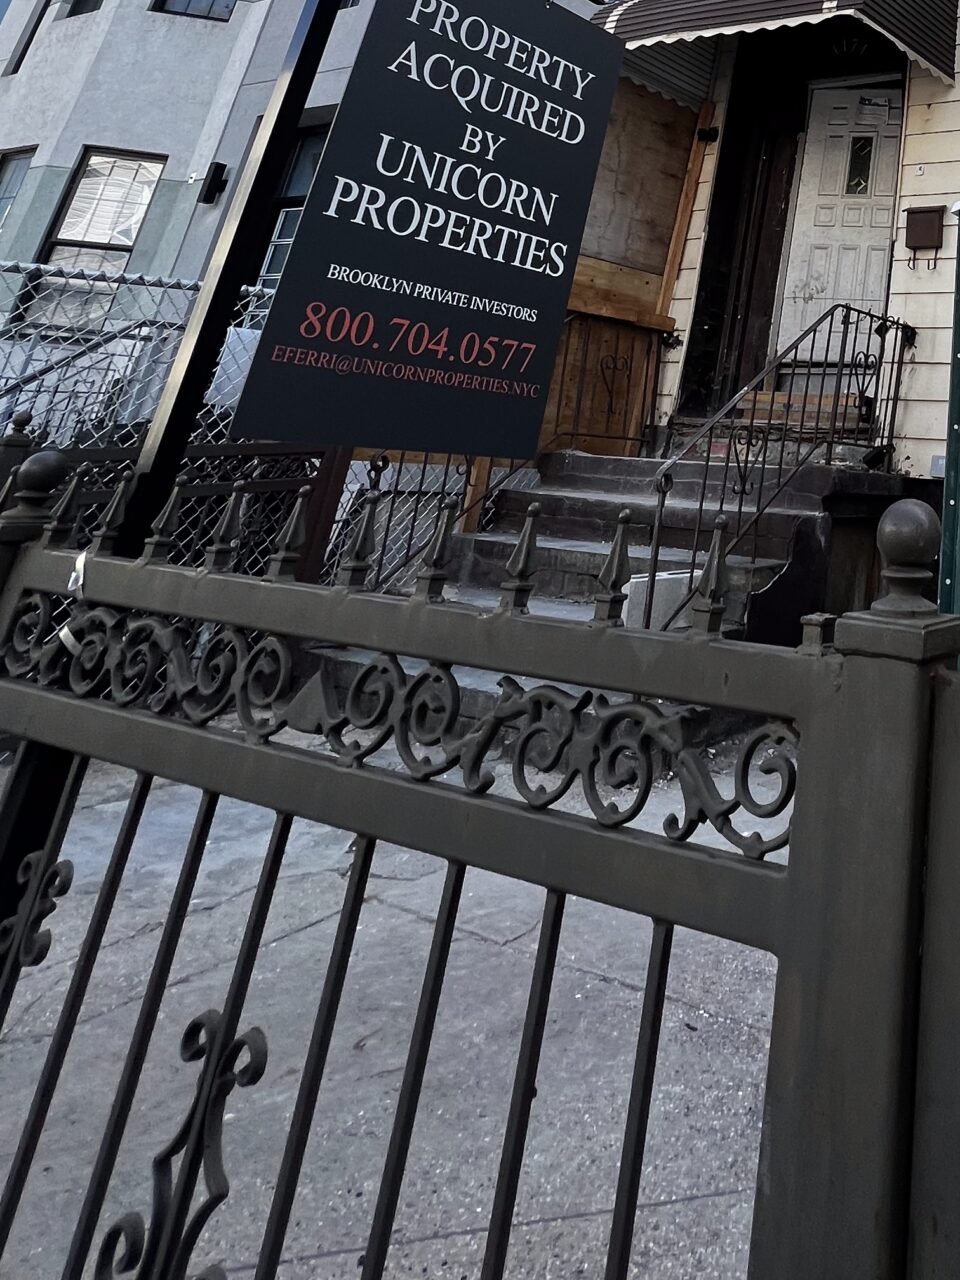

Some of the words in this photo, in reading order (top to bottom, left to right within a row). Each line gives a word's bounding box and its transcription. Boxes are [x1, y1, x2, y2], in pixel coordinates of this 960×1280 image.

[387, 43, 585, 144] ACQUIRED
[459, 123, 506, 161] BY
[376, 133, 559, 226] UNICORN
[323, 176, 567, 277] PROPERTIES
[327, 264, 413, 295] BROOKLYN
[413, 284, 469, 307] PRIVATE
[470, 296, 537, 322] INVESTORS
[272, 346, 540, 398] EFERRI@UNICORNPROPERTIES.NYC
[300, 303, 536, 372] 800.704.0577
